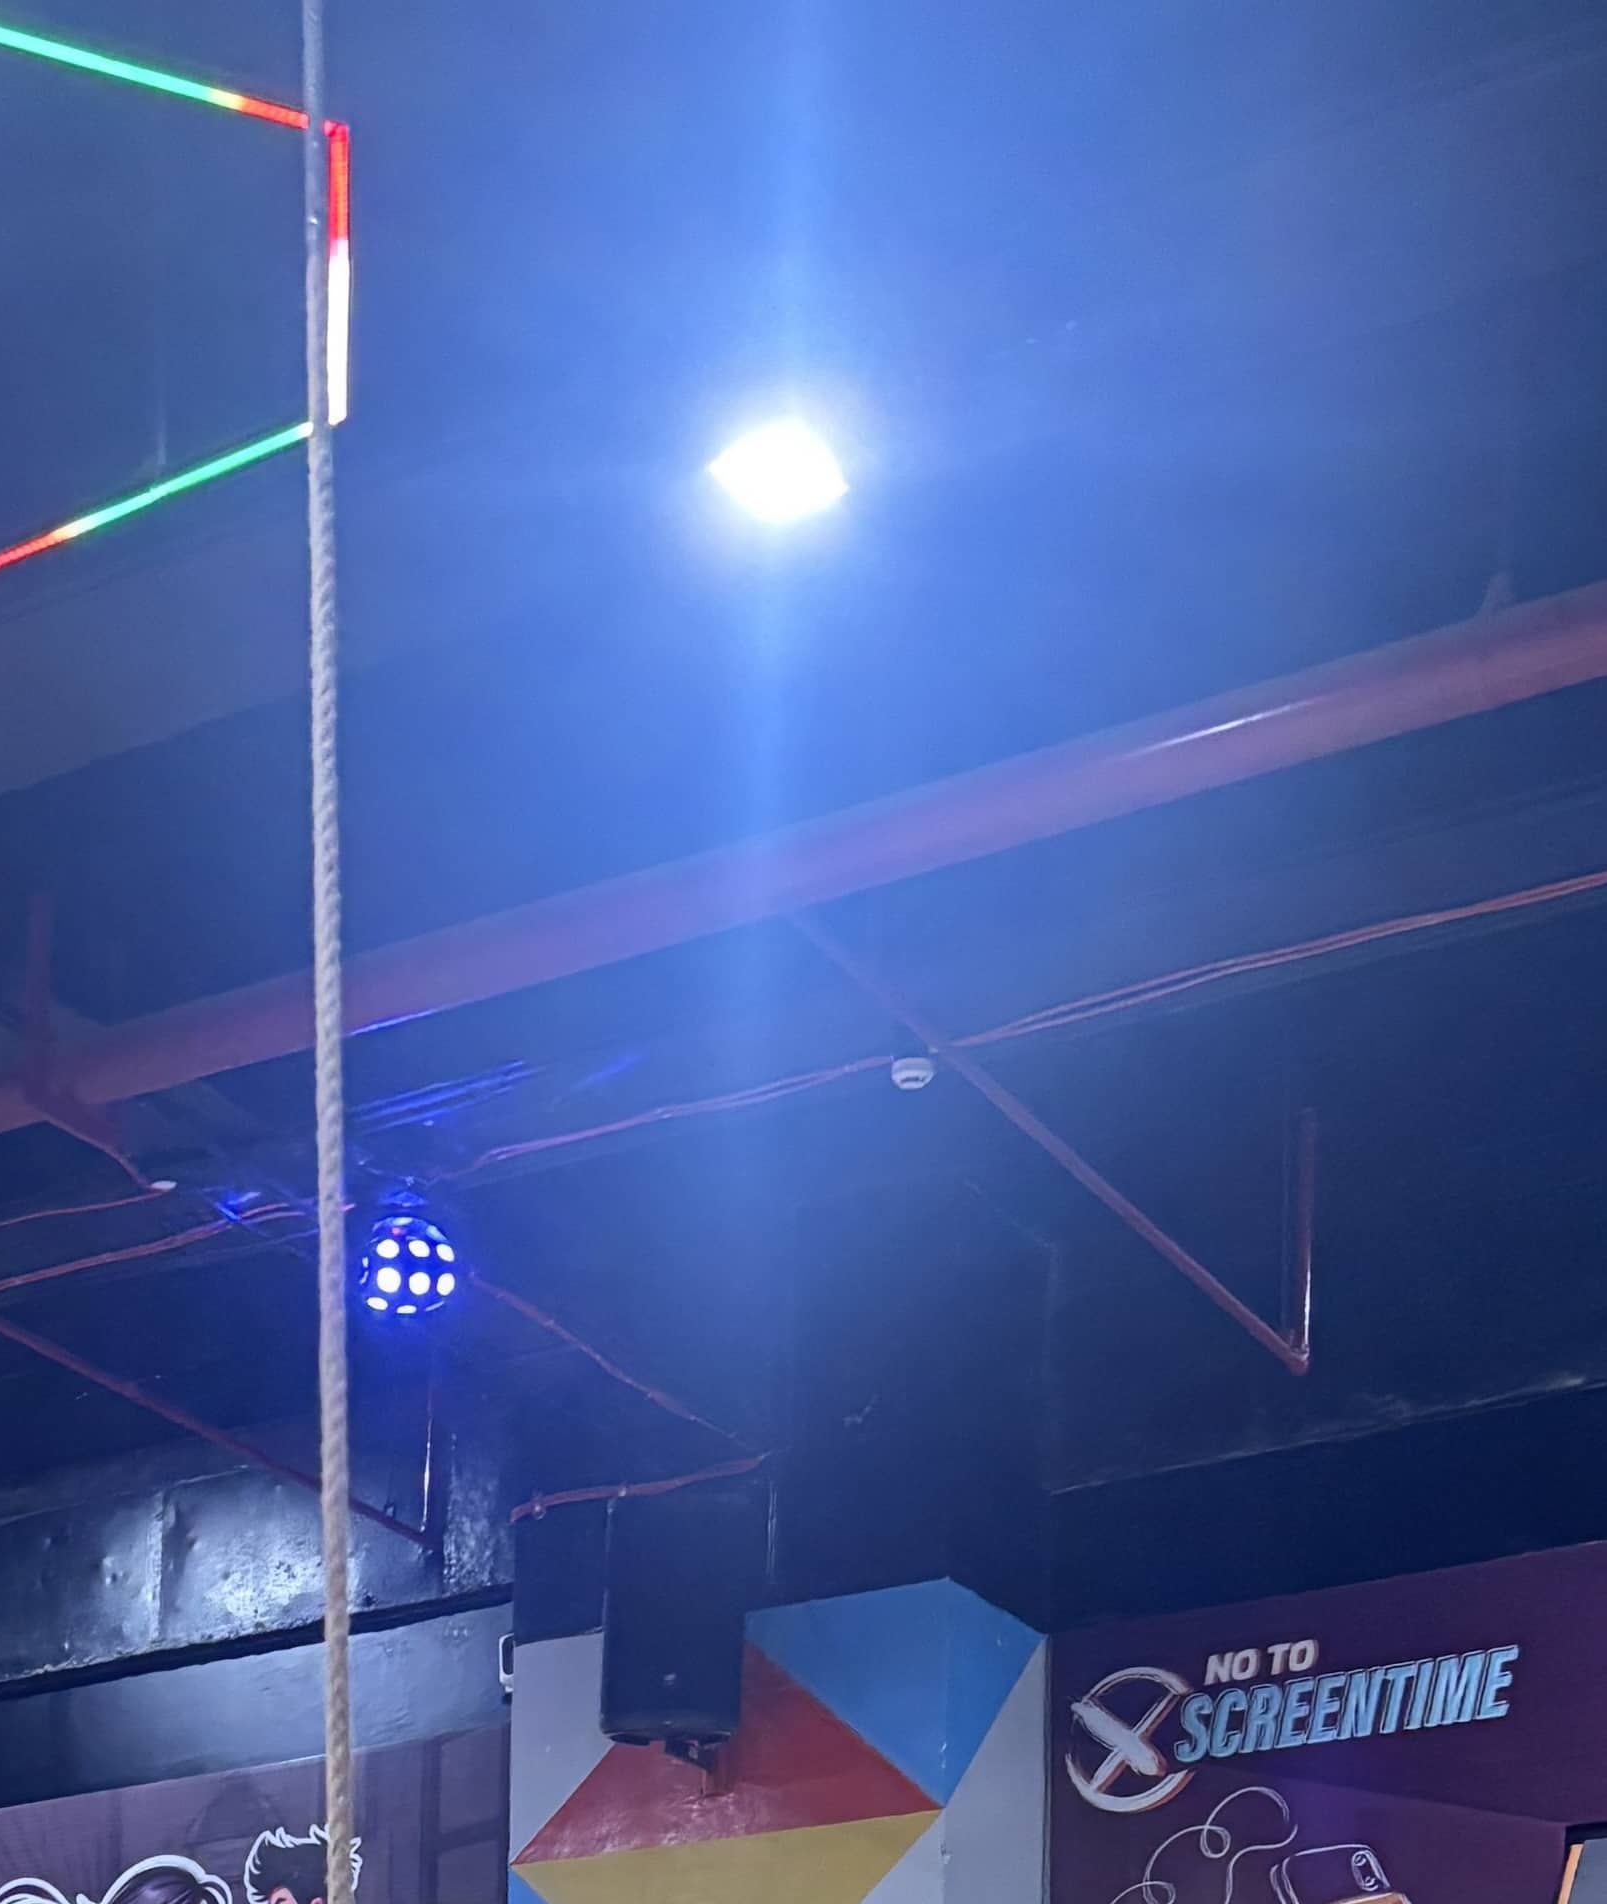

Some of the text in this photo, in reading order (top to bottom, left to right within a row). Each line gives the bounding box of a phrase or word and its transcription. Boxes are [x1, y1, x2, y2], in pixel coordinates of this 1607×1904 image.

[1174, 1644, 1520, 1763] SCREENTIME
[1204, 1639, 1320, 1686] NO TO
